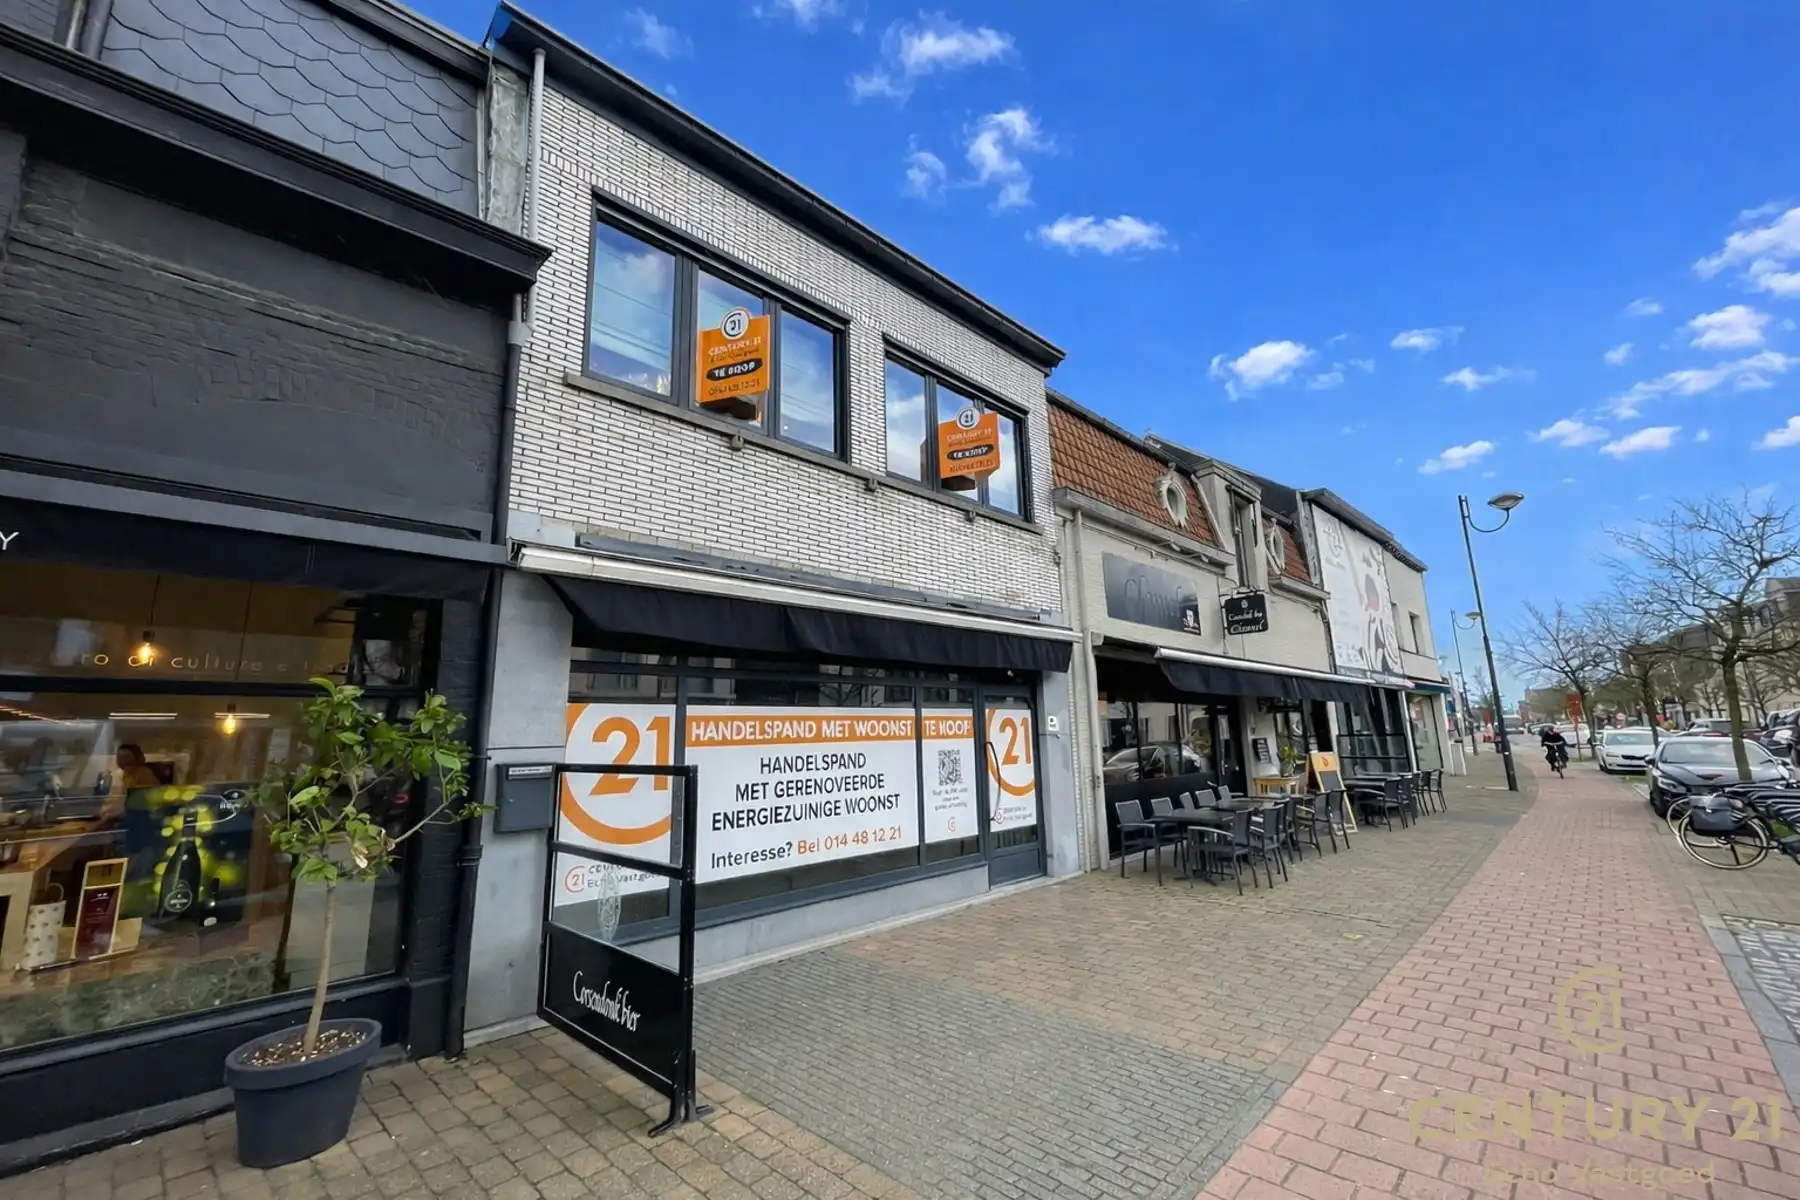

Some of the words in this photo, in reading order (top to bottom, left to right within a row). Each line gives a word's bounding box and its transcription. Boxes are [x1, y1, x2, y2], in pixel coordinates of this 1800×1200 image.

[691, 720, 816, 741] HANDELSPAND
[822, 720, 851, 738] MET
[854, 719, 912, 737] WOONST
[924, 720, 936, 736] TE
[999, 716, 1032, 766] 21
[589, 716, 670, 797] 21
[760, 752, 867, 775] HANDELSPAND
[736, 782, 769, 802] MET
[774, 773, 885, 799] GERENOVEERDE
[712, 799, 842, 831] ENERGIEZUINIGE
[845, 793, 901, 814] WOONST
[711, 841, 793, 869] Interesse?
[797, 839, 820, 855] Bel
[824, 832, 849, 850] 014
[852, 830, 869, 844] 48
[872, 828, 887, 843] 12
[889, 825, 902, 840] 21
